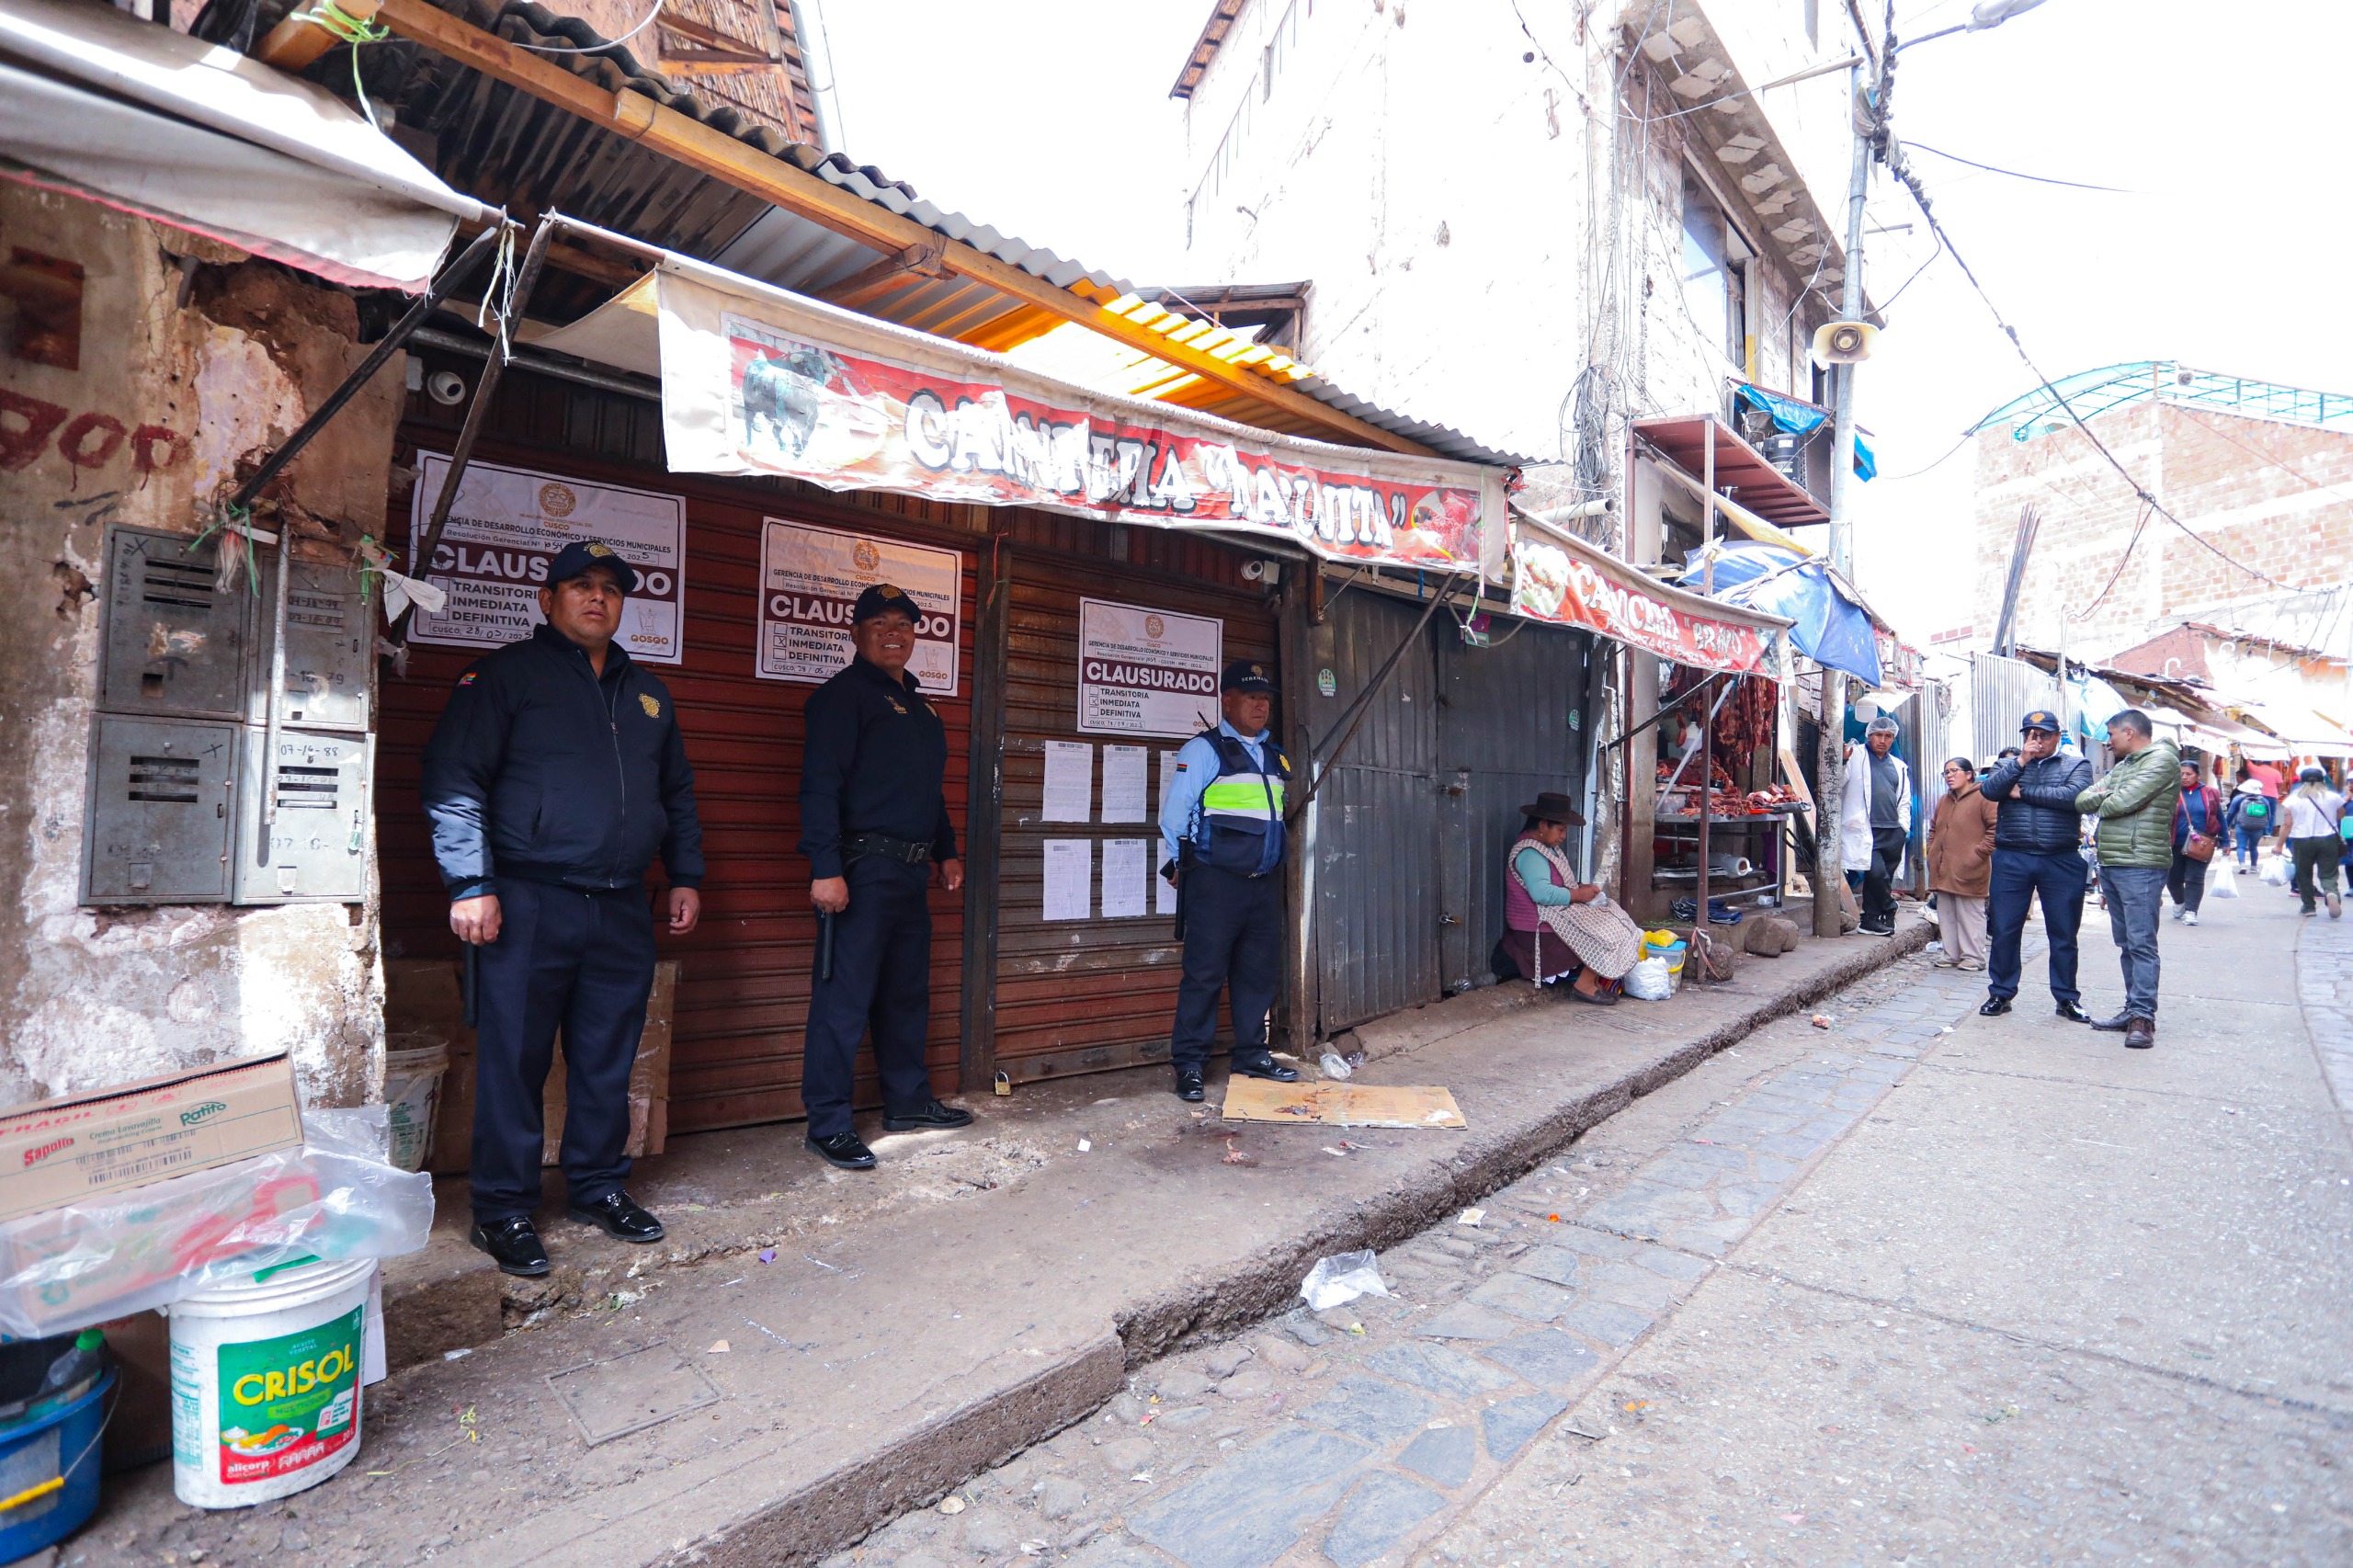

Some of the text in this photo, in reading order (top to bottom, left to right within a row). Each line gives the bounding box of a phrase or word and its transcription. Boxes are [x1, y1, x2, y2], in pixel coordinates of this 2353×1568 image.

[429, 513, 470, 527] GENCIA
[472, 518, 483, 528] DE
[484, 521, 535, 535] DESARROLLO
[537, 528, 580, 540] ECONÓMICO
[588, 536, 625, 547] SERVICIOS
[626, 541, 671, 553] MUNICIPALES
[543, 521, 570, 530] CUSCO
[447, 529, 491, 541] Resolución
[493, 536, 529, 546] Gerencial
[429, 543, 672, 596] CLAUSO
[454, 582, 539, 599] TRANSITORI
[773, 569, 802, 579] GERENCIA
[813, 574, 849, 585] DESARROLLO
[916, 590, 950, 601] MUNICIPALES
[785, 582, 817, 592] Resolución
[819, 587, 846, 596] Gerencial
[452, 597, 529, 613] INMEDIATA
[451, 610, 530, 627] DEFINITIVA
[769, 595, 950, 638] CLAUSDO
[630, 634, 669, 645] QOSQO
[790, 627, 853, 642] TRANSITORI
[789, 639, 845, 653] INMEDIATA
[1088, 641, 1110, 649] GERENCIA
[1117, 644, 1143, 653] DESARROLLO
[1170, 651, 1189, 659] SERVICIOS
[1190, 653, 1214, 662] MUNICIPALES
[789, 651, 847, 665] DEFINITIVA
[918, 670, 948, 679] QOSQO
[1086, 661, 1215, 693] CLAUSURADO
[1100, 687, 1150, 699] TRANSITORIA
[1099, 699, 1141, 708] INMEDIATA
[1099, 709, 1142, 719] DEFINITIVA
[179, 1103, 227, 1127] Patito
[89, 1117, 162, 1142] Crema Lavavajilla
[233, 1344, 355, 1406] CRISOL
[227, 1460, 270, 1474] alicorp
